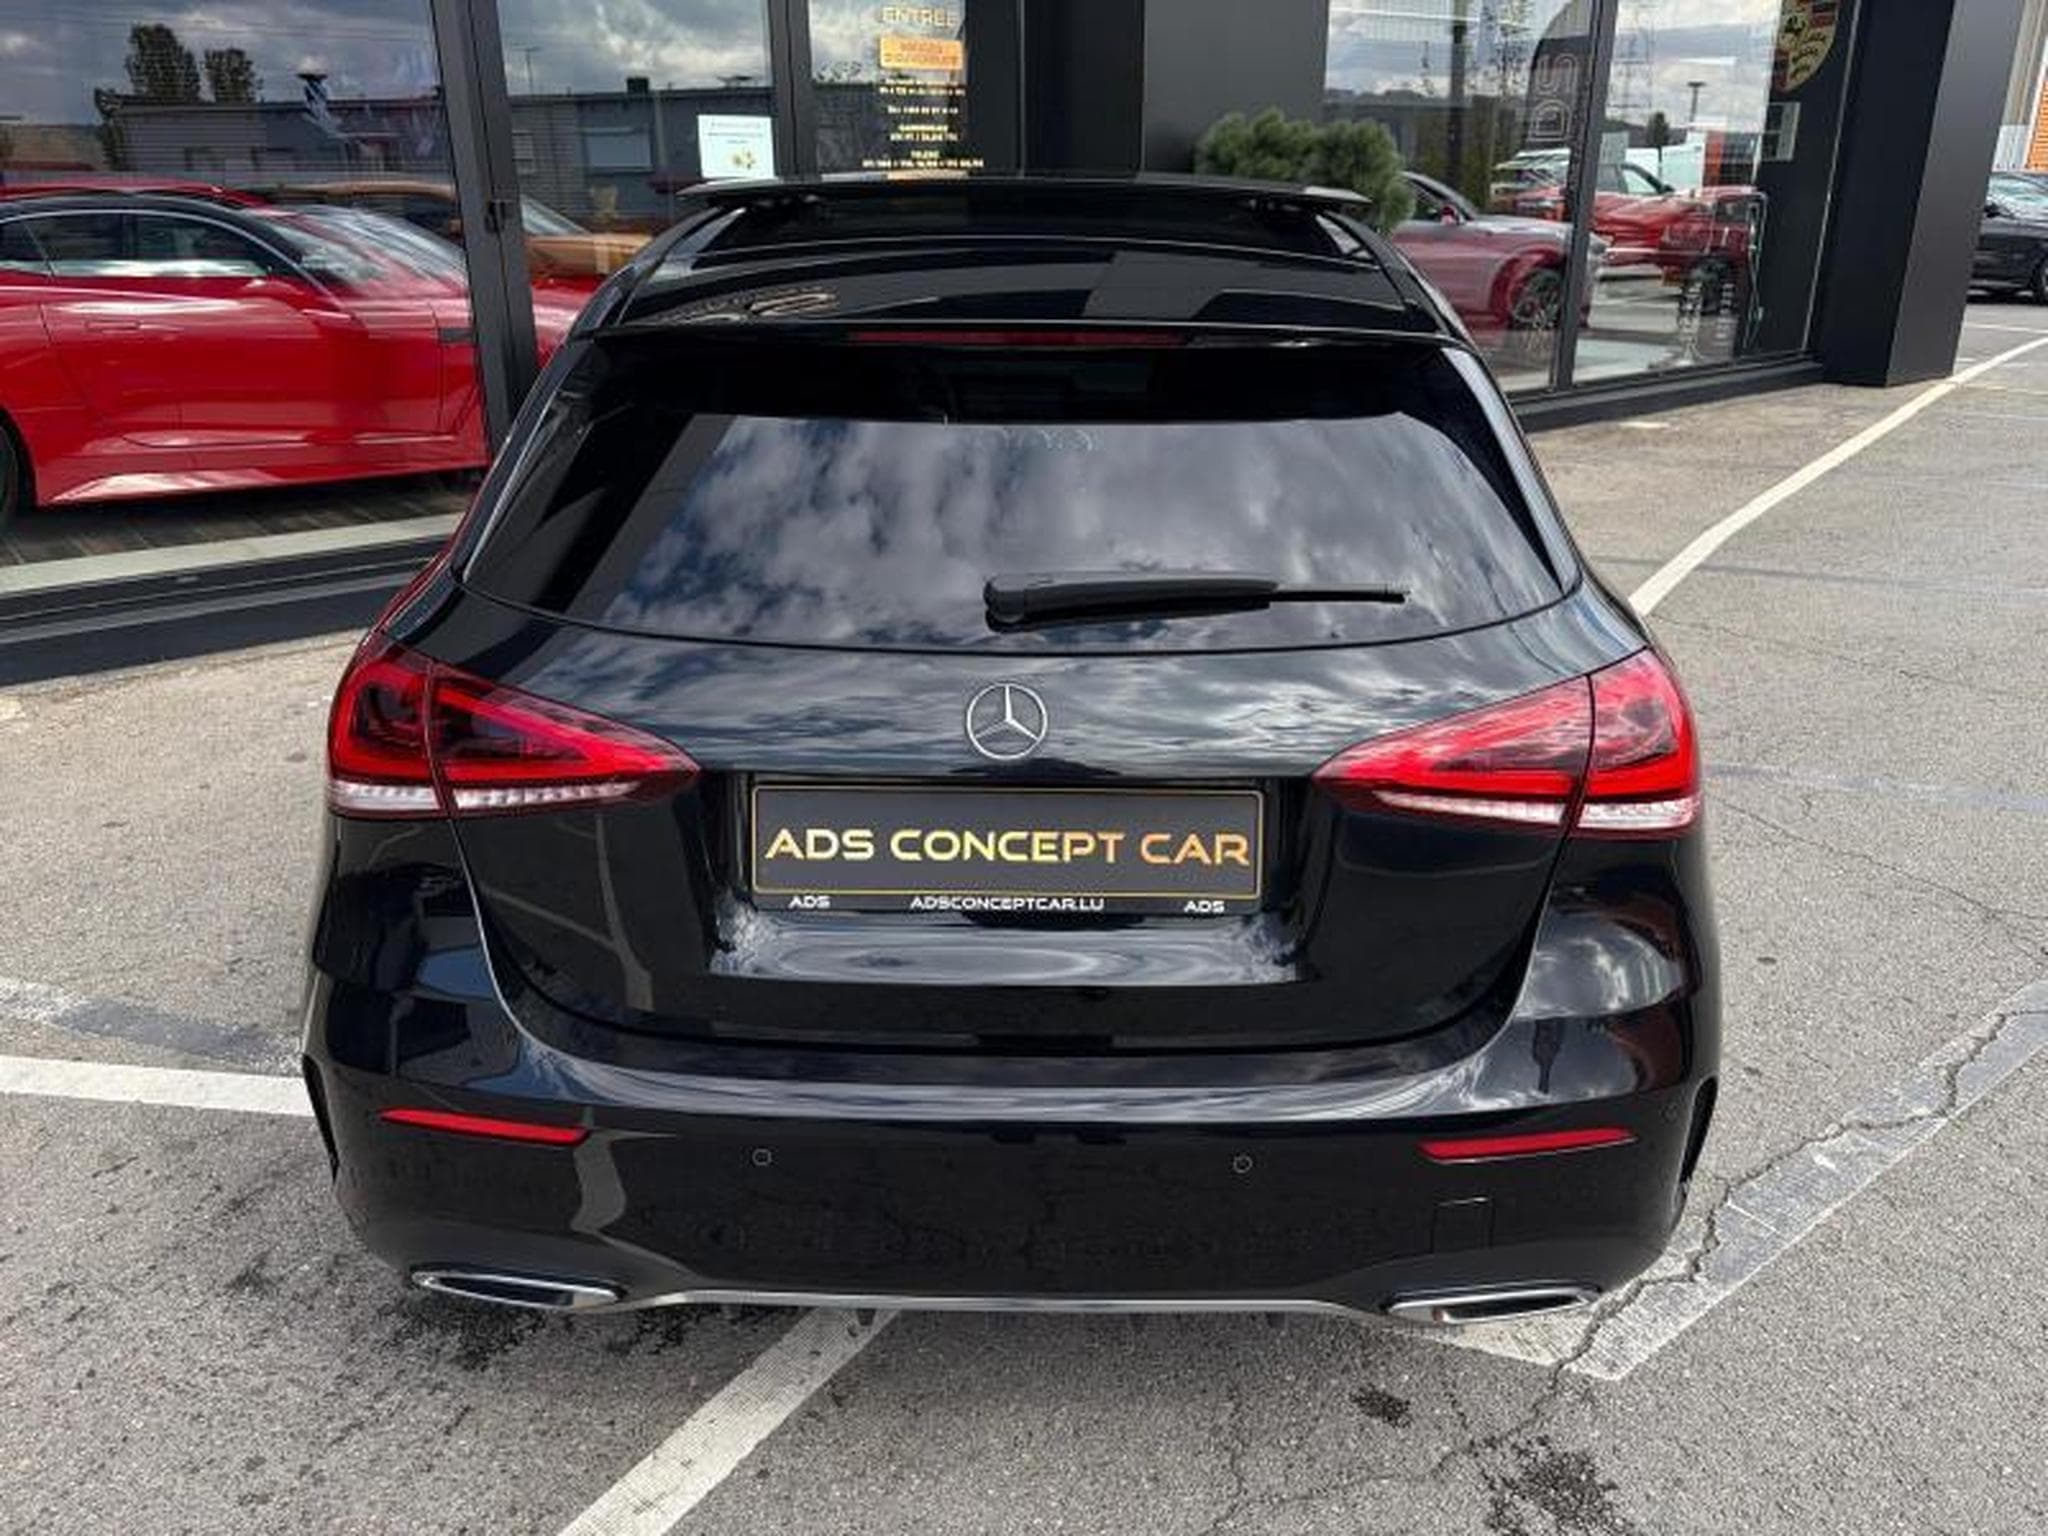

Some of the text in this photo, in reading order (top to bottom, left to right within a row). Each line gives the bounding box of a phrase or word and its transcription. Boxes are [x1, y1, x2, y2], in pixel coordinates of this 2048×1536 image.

[765, 828, 1250, 866] ADS CONCEPT CAR
[788, 896, 831, 909] ADS
[909, 896, 1105, 911] ADSCONCEPTCAR.LU
[1183, 900, 1225, 914] ADS
